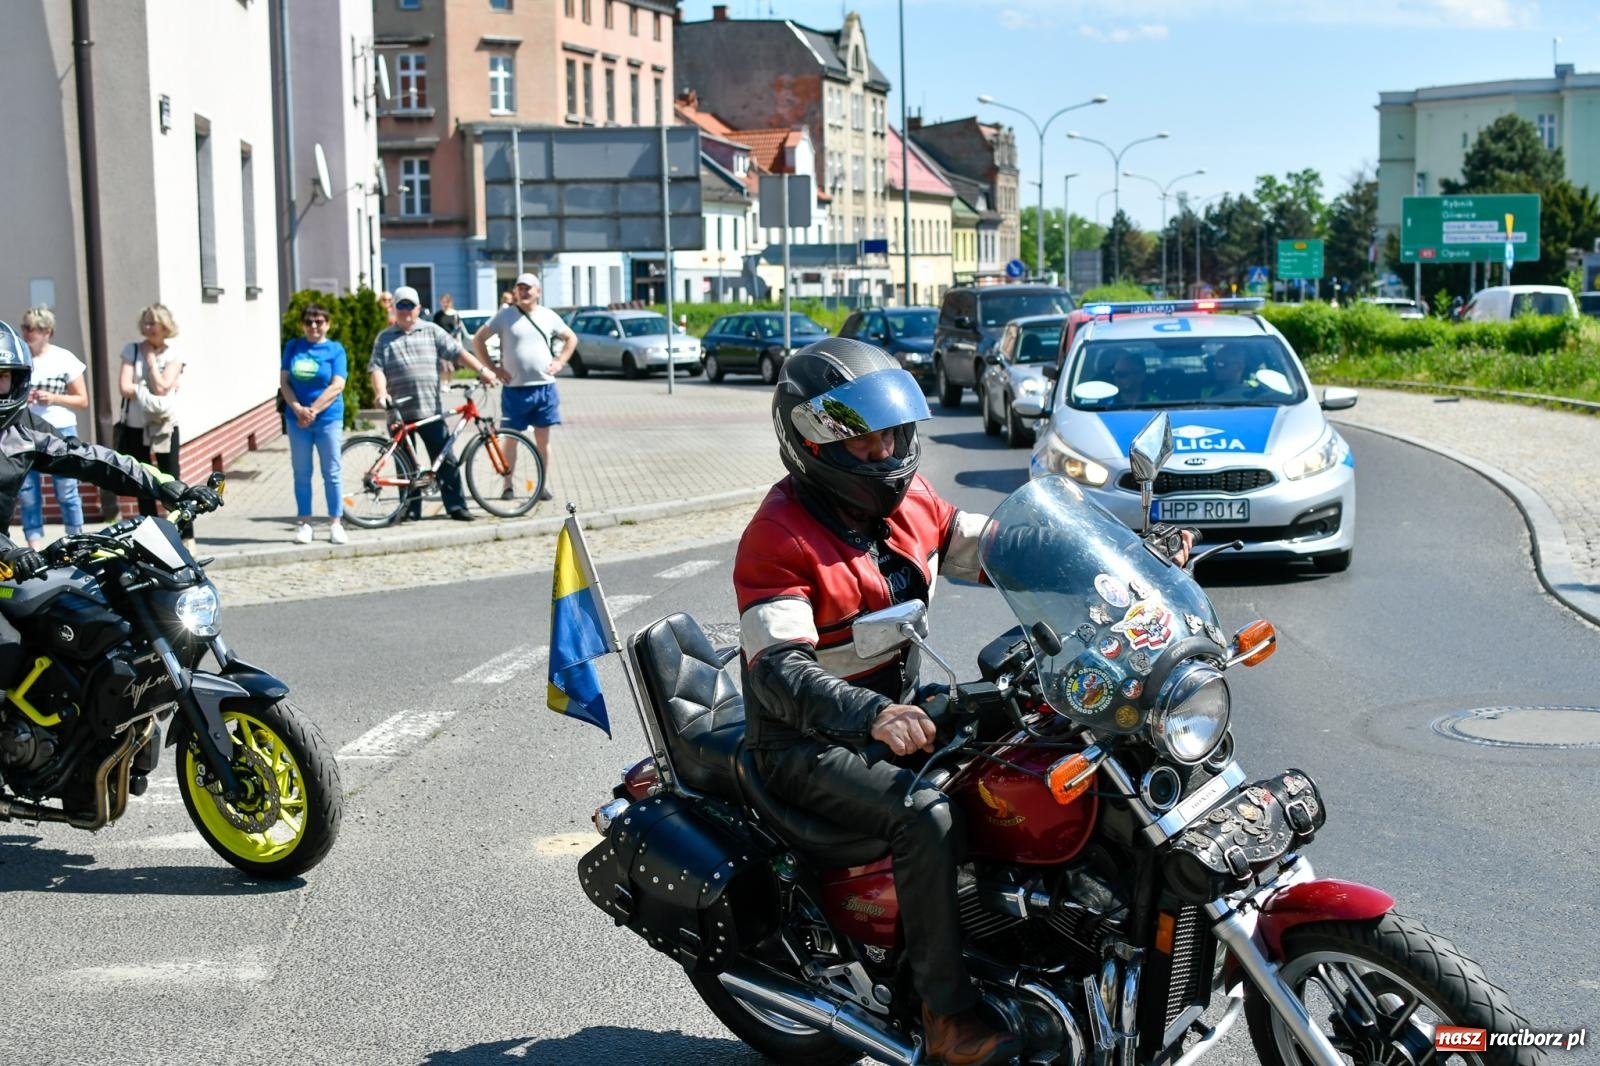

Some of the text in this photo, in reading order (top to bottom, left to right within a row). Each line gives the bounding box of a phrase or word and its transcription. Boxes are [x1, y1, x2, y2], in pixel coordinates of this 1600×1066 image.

[1175, 437, 1247, 451] LICJA
[1161, 501, 1246, 519] HPP R014
